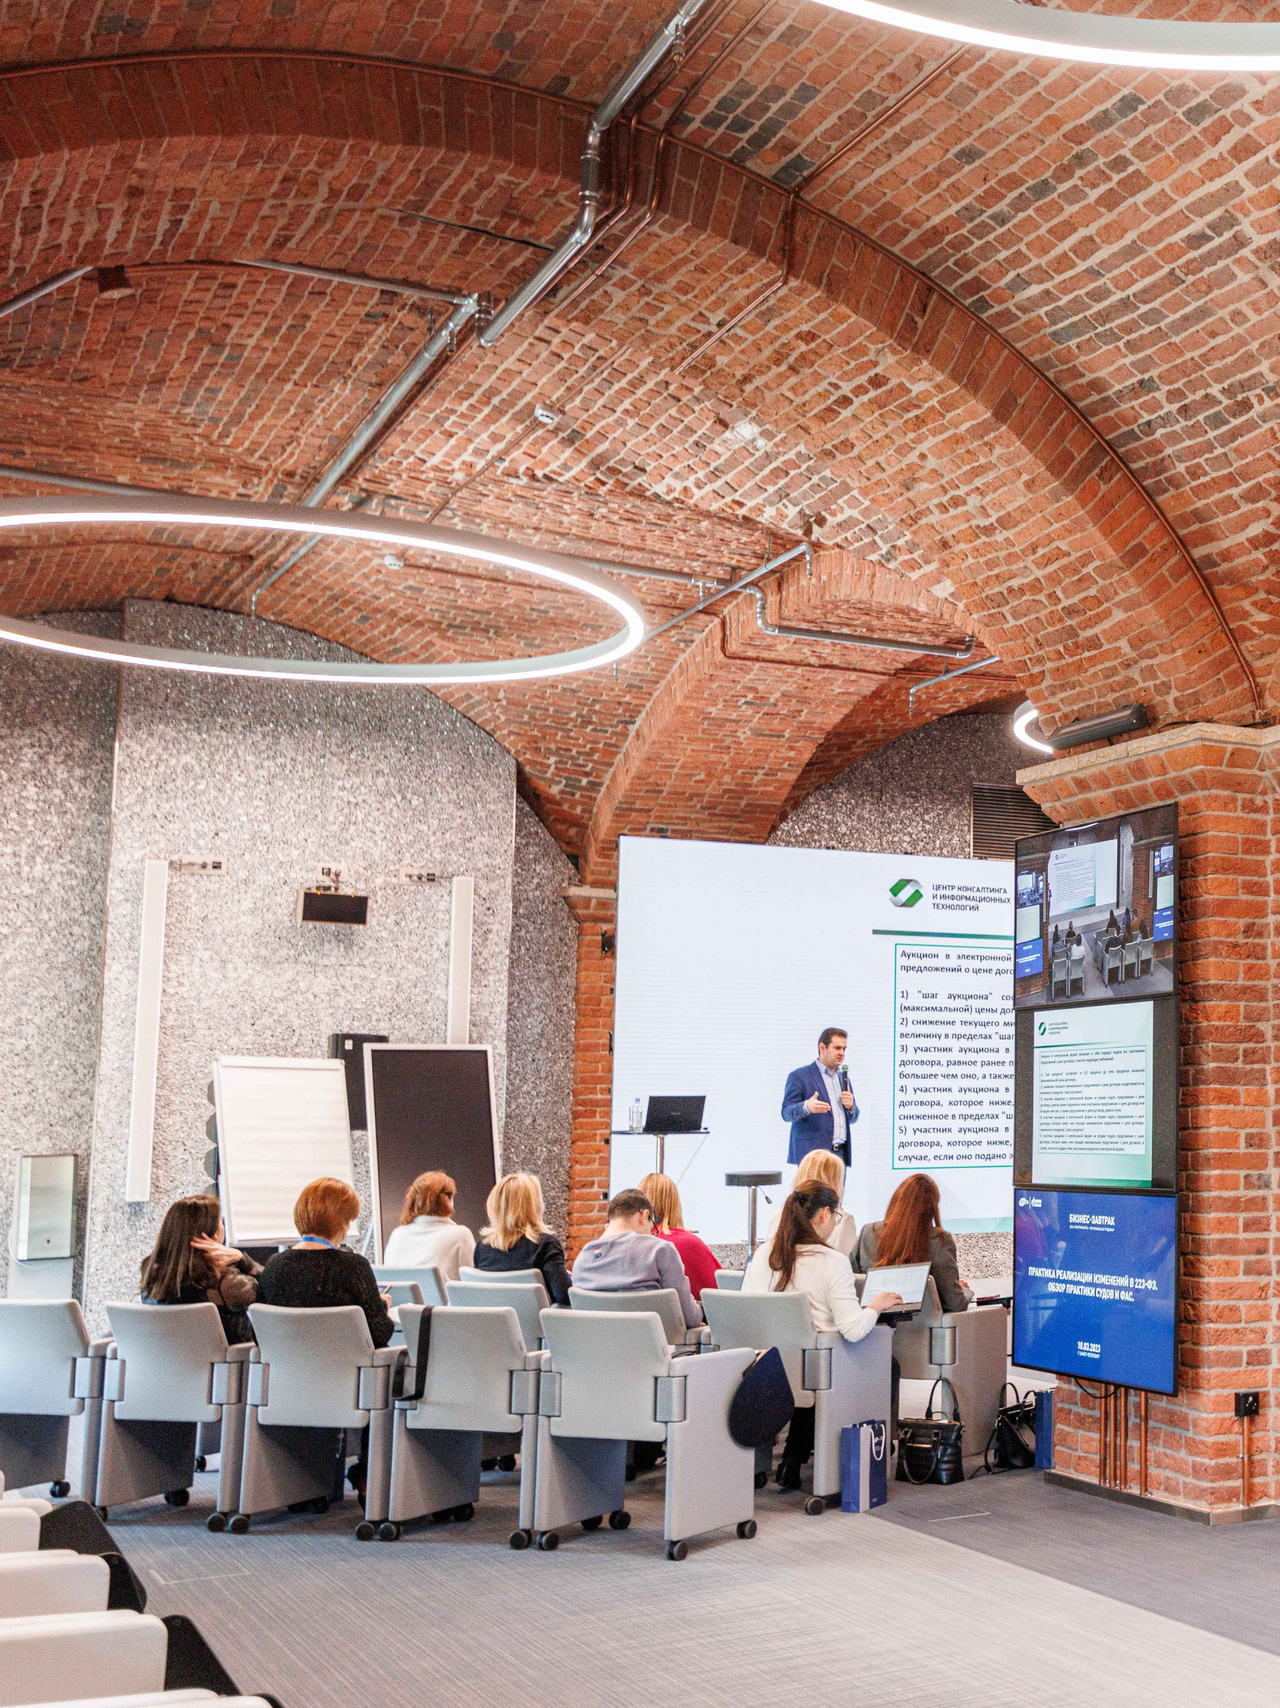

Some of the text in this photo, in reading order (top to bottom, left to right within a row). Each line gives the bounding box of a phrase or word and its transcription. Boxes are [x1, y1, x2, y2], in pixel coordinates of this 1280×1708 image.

[932, 884, 1008, 894] ЦЕНТР КОНСАЛТИНГА
[940, 894, 1011, 903] ИНФОРМАЦИОННЫХ
[932, 903, 979, 911] ТЕХНОЛОГИЙ
[900, 950, 939, 960] Аукцион
[957, 954, 1011, 962] электронной
[900, 965, 962, 974] предложений
[900, 990, 908, 1000] 1)
[948, 992, 992, 1001] аукциона"
[900, 1004, 972, 1014] (максимальной)
[975, 1007, 997, 1015] цены
[900, 1017, 908, 1027] 2)
[960, 1020, 999, 1028] текущего
[900, 1044, 908, 1054] 3)
[913, 1046, 953, 1054] участник
[899, 1060, 943, 1068] договора,
[947, 1060, 977, 1068] равное
[981, 1060, 1006, 1068] ранее
[899, 1071, 938, 1079] большее
[899, 1085, 907, 1095] 4)
[899, 1100, 943, 1108] договора,
[949, 1100, 983, 1108] которое
[959, 1113, 999, 1121] пределах
[899, 1126, 907, 1135] 5)
[913, 1127, 952, 1135] участник
[958, 1127, 999, 1135] аукциона
[898, 1141, 943, 1149] договора,
[947, 1140, 982, 1148] которое
[898, 1155, 930, 1163] случае,
[1069, 1214, 1115, 1226] БИЗНЕС-ЗАВТРАК
[1029, 1266, 1158, 1291] ПРАКТИКА РЕАЛИЗАЦИИ ИЗМЕНЕНИЙ В 223-ФЗ.
[1048, 1282, 1134, 1302] ОБЗОР ПРАКТИКИ СУДОВ И ФАС.
[1078, 1341, 1101, 1353] 10.03.2023
